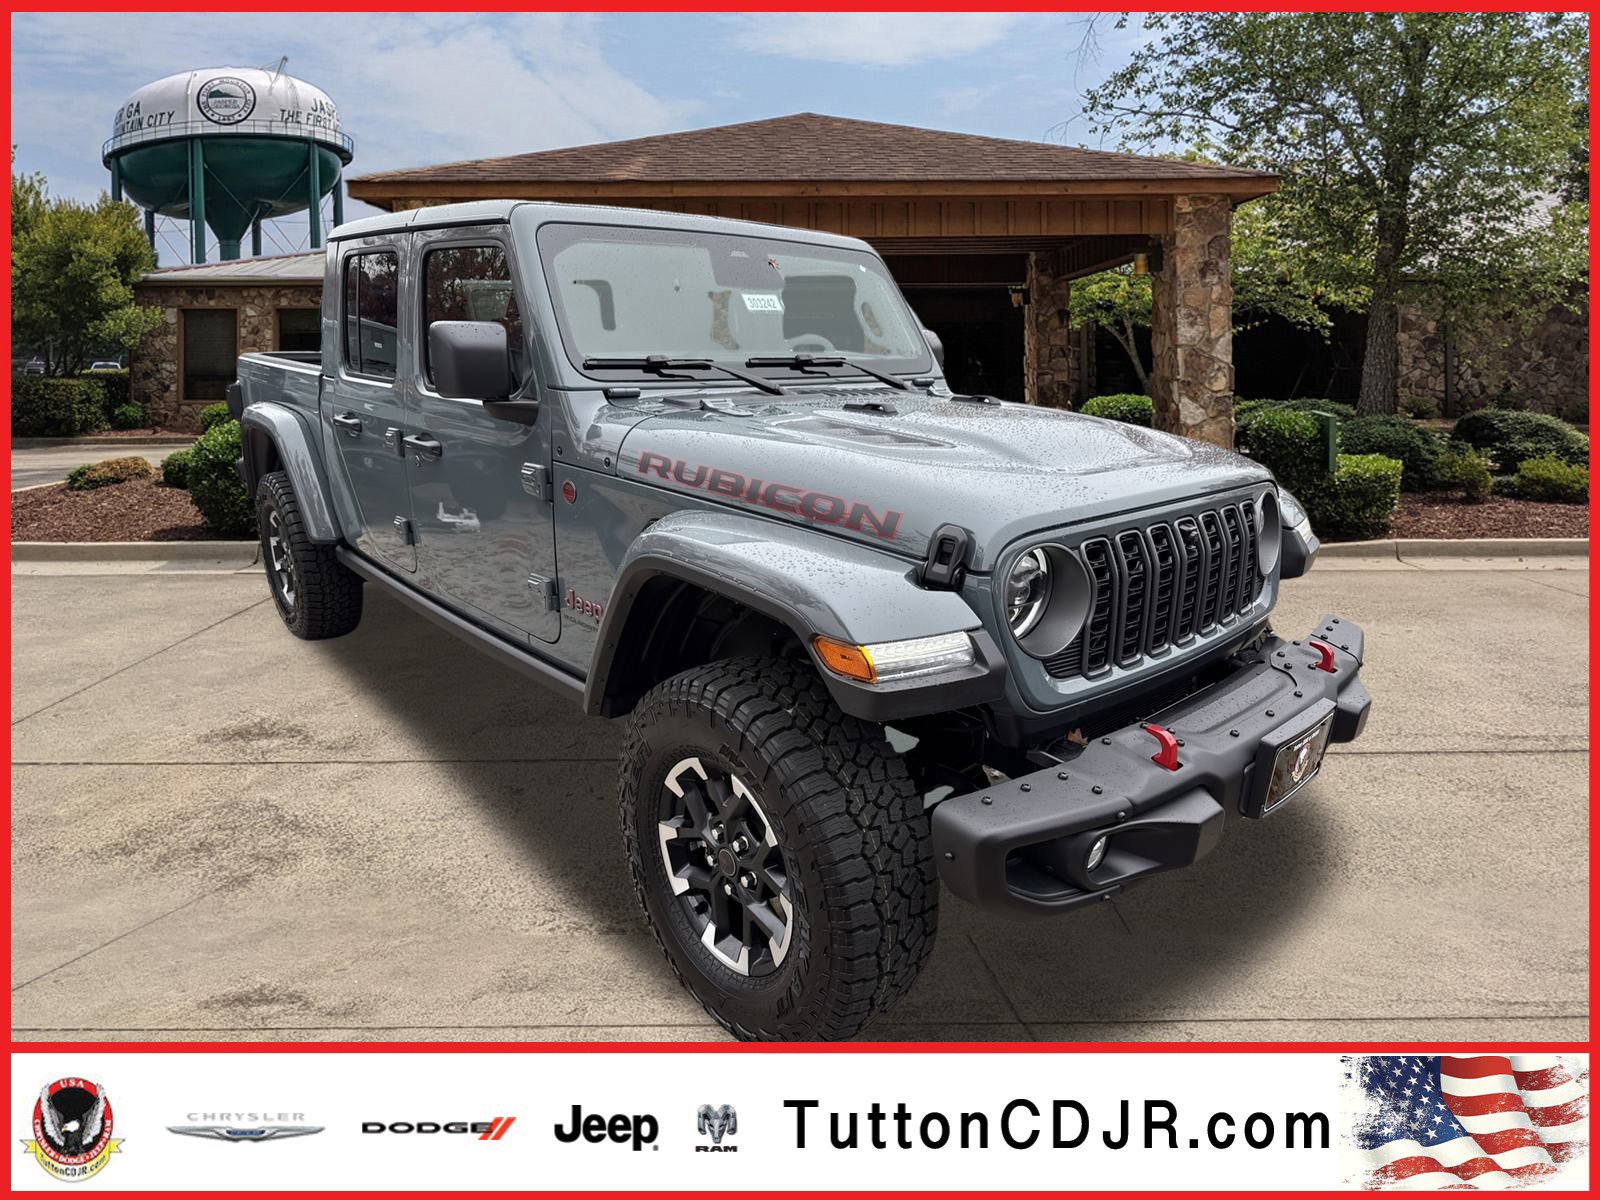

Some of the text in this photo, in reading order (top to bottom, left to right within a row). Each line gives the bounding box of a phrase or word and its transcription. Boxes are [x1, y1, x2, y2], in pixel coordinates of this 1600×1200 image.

[126, 101, 141, 119] GA
[147, 110, 175, 128] CITY
[280, 108, 302, 124] THE
[306, 112, 332, 130] FIRST
[638, 451, 903, 539] RUBICON
[565, 588, 603, 624] Jeep
